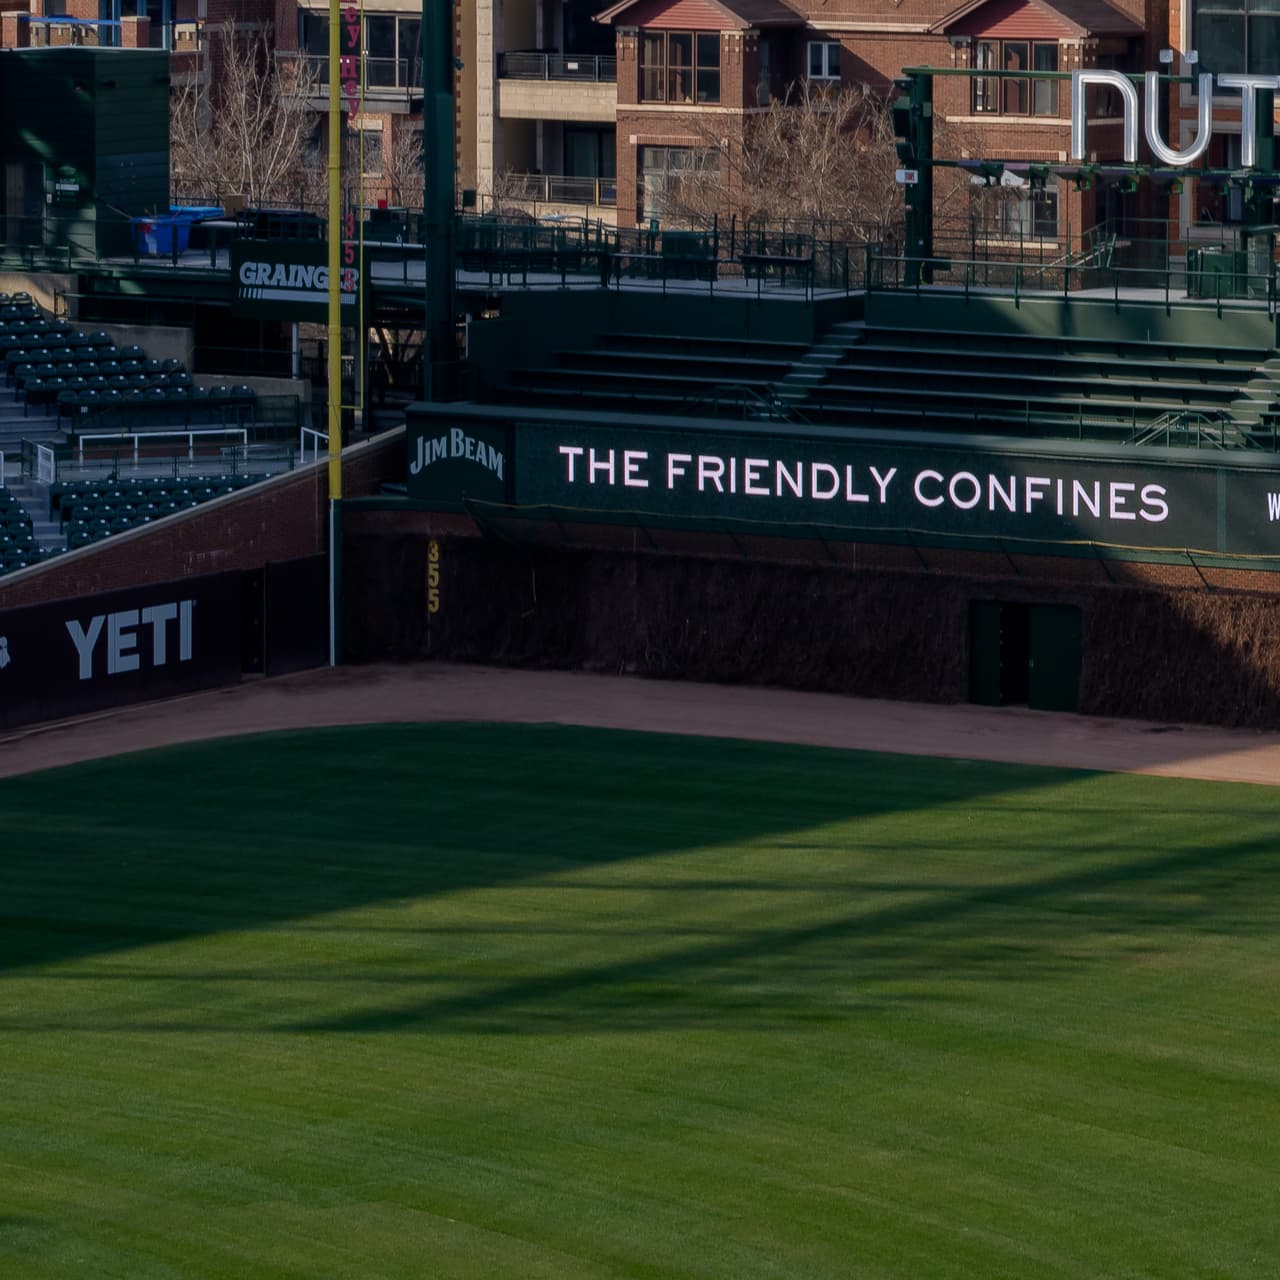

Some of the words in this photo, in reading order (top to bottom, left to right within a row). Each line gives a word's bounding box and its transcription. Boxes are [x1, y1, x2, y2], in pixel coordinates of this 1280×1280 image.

[239, 261, 360, 292] GRAINGR
[410, 435, 447, 475] JIM
[450, 427, 504, 481] BEAM
[559, 445, 649, 488] THE
[667, 453, 897, 504] FRIENDLY
[914, 468, 1169, 523] CONFINES
[427, 539, 440, 614] 355
[65, 599, 193, 680] YETI
